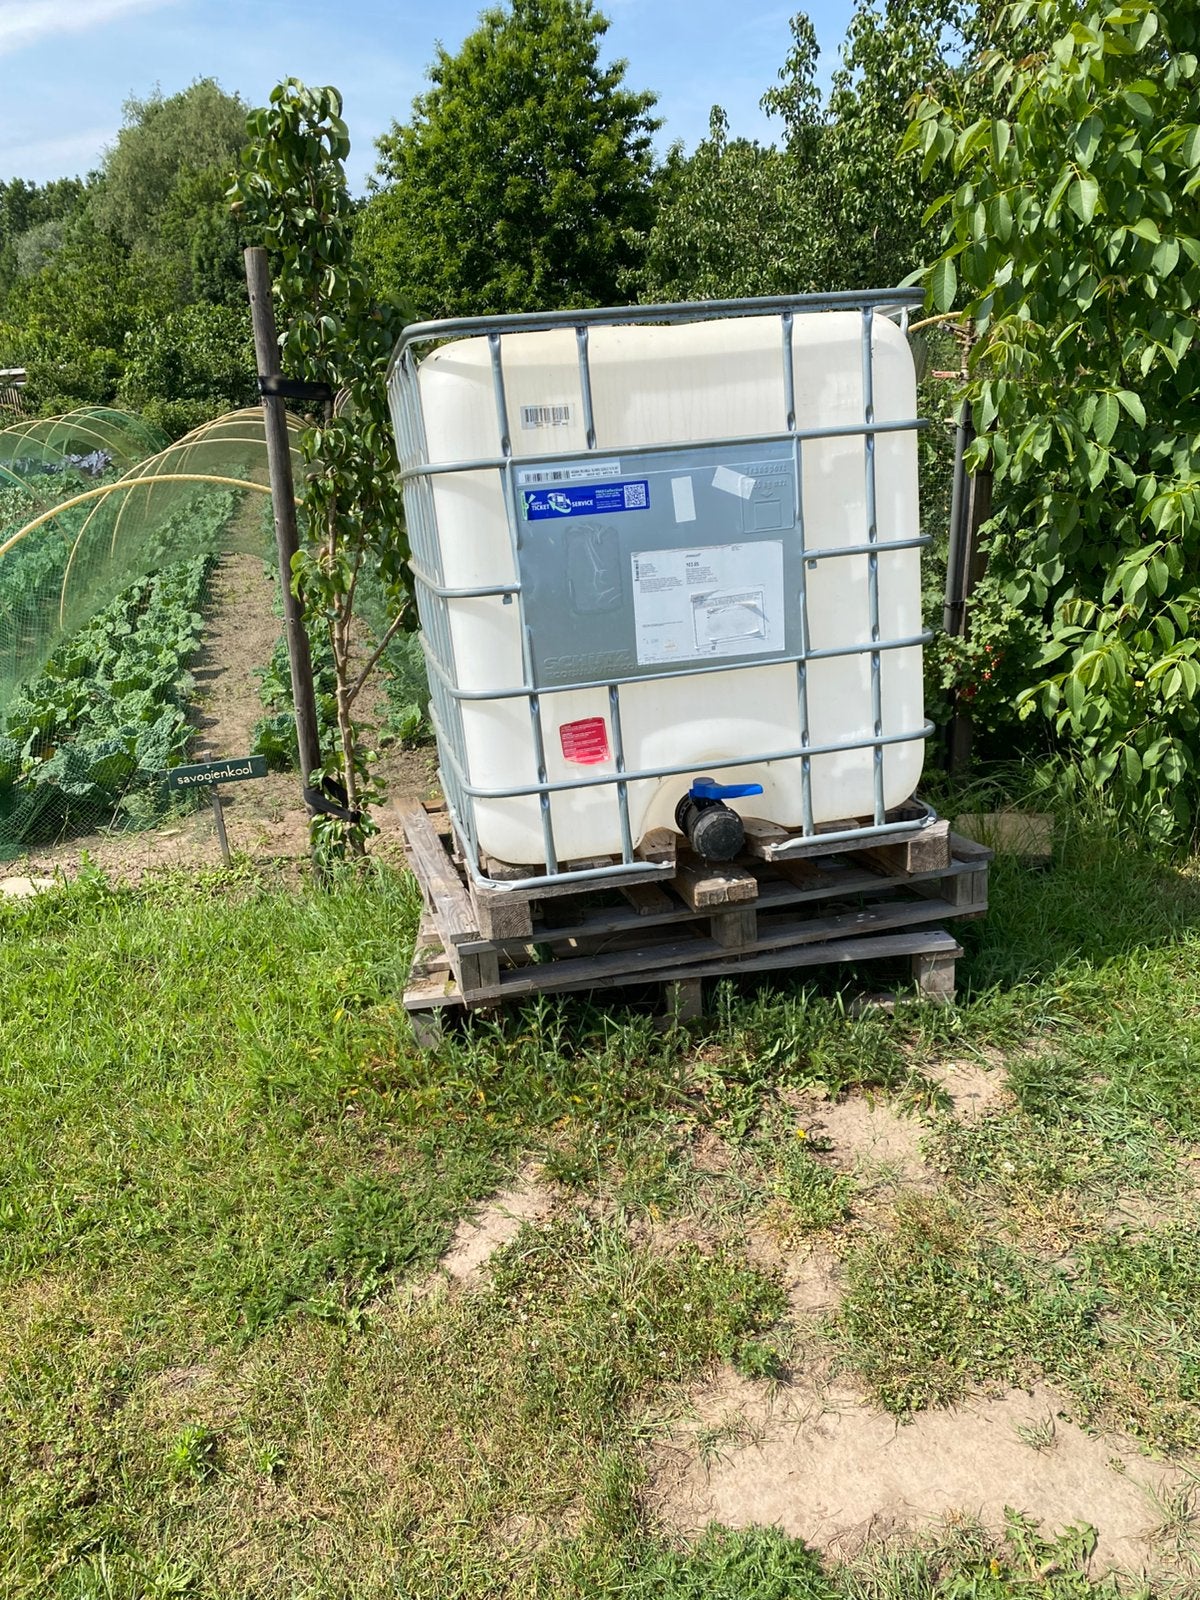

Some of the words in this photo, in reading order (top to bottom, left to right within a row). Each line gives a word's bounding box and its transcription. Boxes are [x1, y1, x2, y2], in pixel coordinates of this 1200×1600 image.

[531, 503, 550, 511] TICKET
[571, 499, 594, 508] SERVICE
[177, 761, 253, 785] savooienkool
